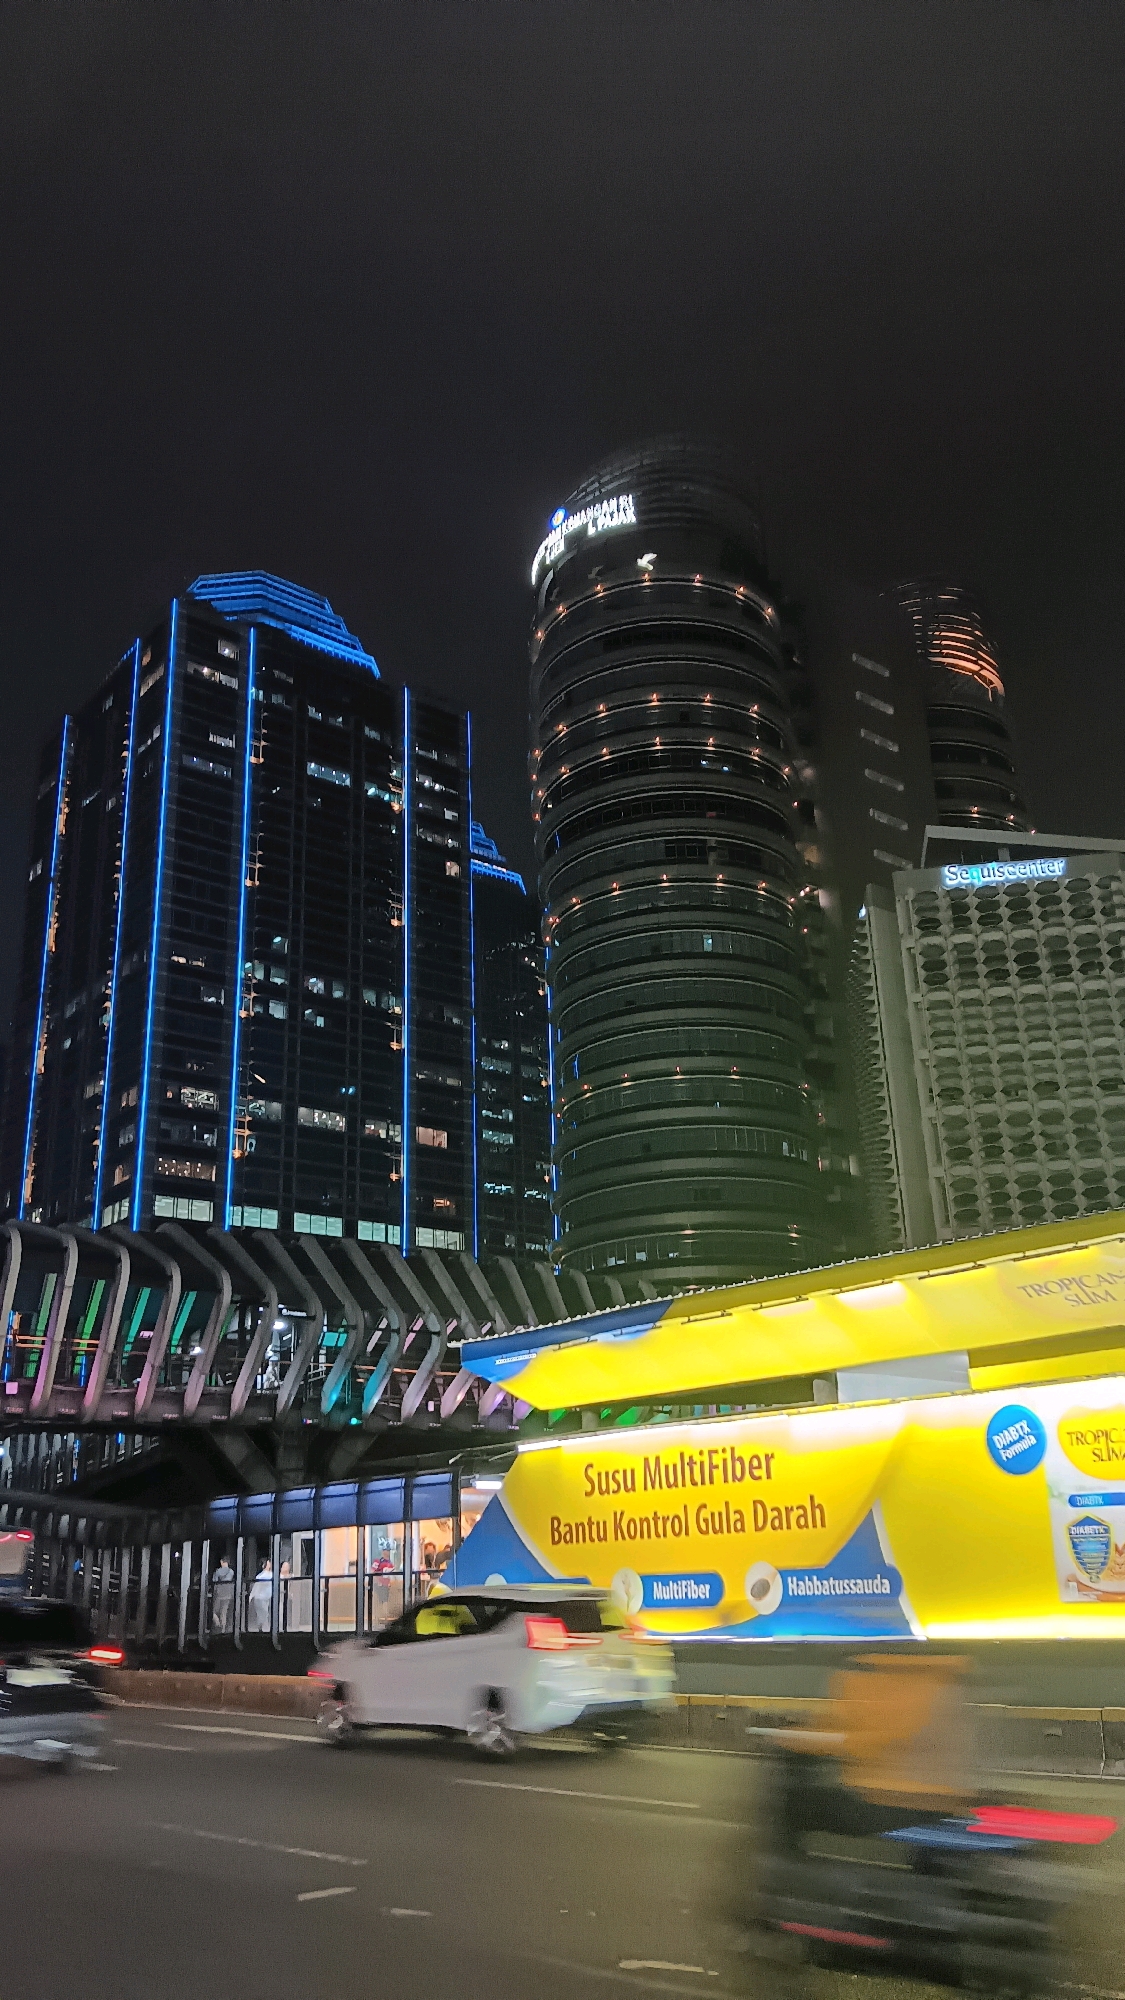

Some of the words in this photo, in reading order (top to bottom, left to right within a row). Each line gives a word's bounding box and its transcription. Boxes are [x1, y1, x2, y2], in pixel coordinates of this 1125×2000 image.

[1064, 1289, 1118, 1308] SLIM
[992, 1419, 1032, 1450] DIABTX
[999, 1434, 1038, 1462] Formula
[584, 1463, 636, 1498] Susu
[642, 1446, 775, 1492] MultiFiber
[550, 1515, 608, 1545] Bantu
[613, 1504, 690, 1542] Kontrol
[695, 1501, 746, 1538] Gula
[753, 1494, 827, 1532] Darah
[653, 1579, 711, 1601] MultiFiber
[787, 1574, 891, 1597] Habbatussauda
